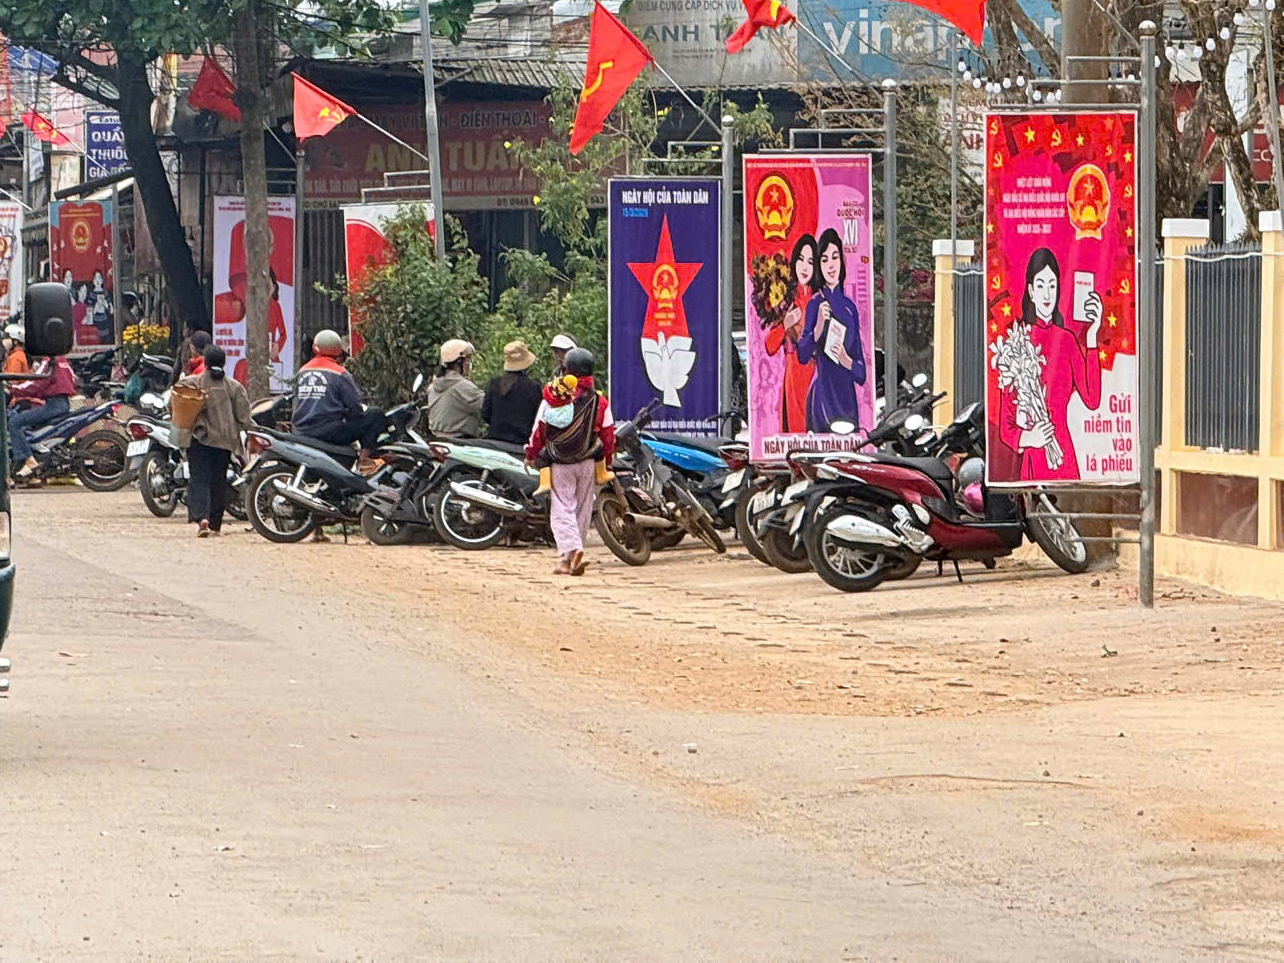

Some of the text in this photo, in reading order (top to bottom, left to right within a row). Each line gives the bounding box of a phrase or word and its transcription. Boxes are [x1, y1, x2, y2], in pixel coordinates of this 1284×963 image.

[643, 24, 699, 42] ANH
[622, 185, 709, 206] NGÀY HỘI CỦA TOÀN DÂN
[843, 218, 858, 246] XVI
[1109, 392, 1131, 413] Gửi
[1084, 413, 1132, 433] niềm tin
[764, 437, 785, 454] NGÀY
[1112, 434, 1132, 452] vào
[1086, 451, 1133, 476] lá phiếu
